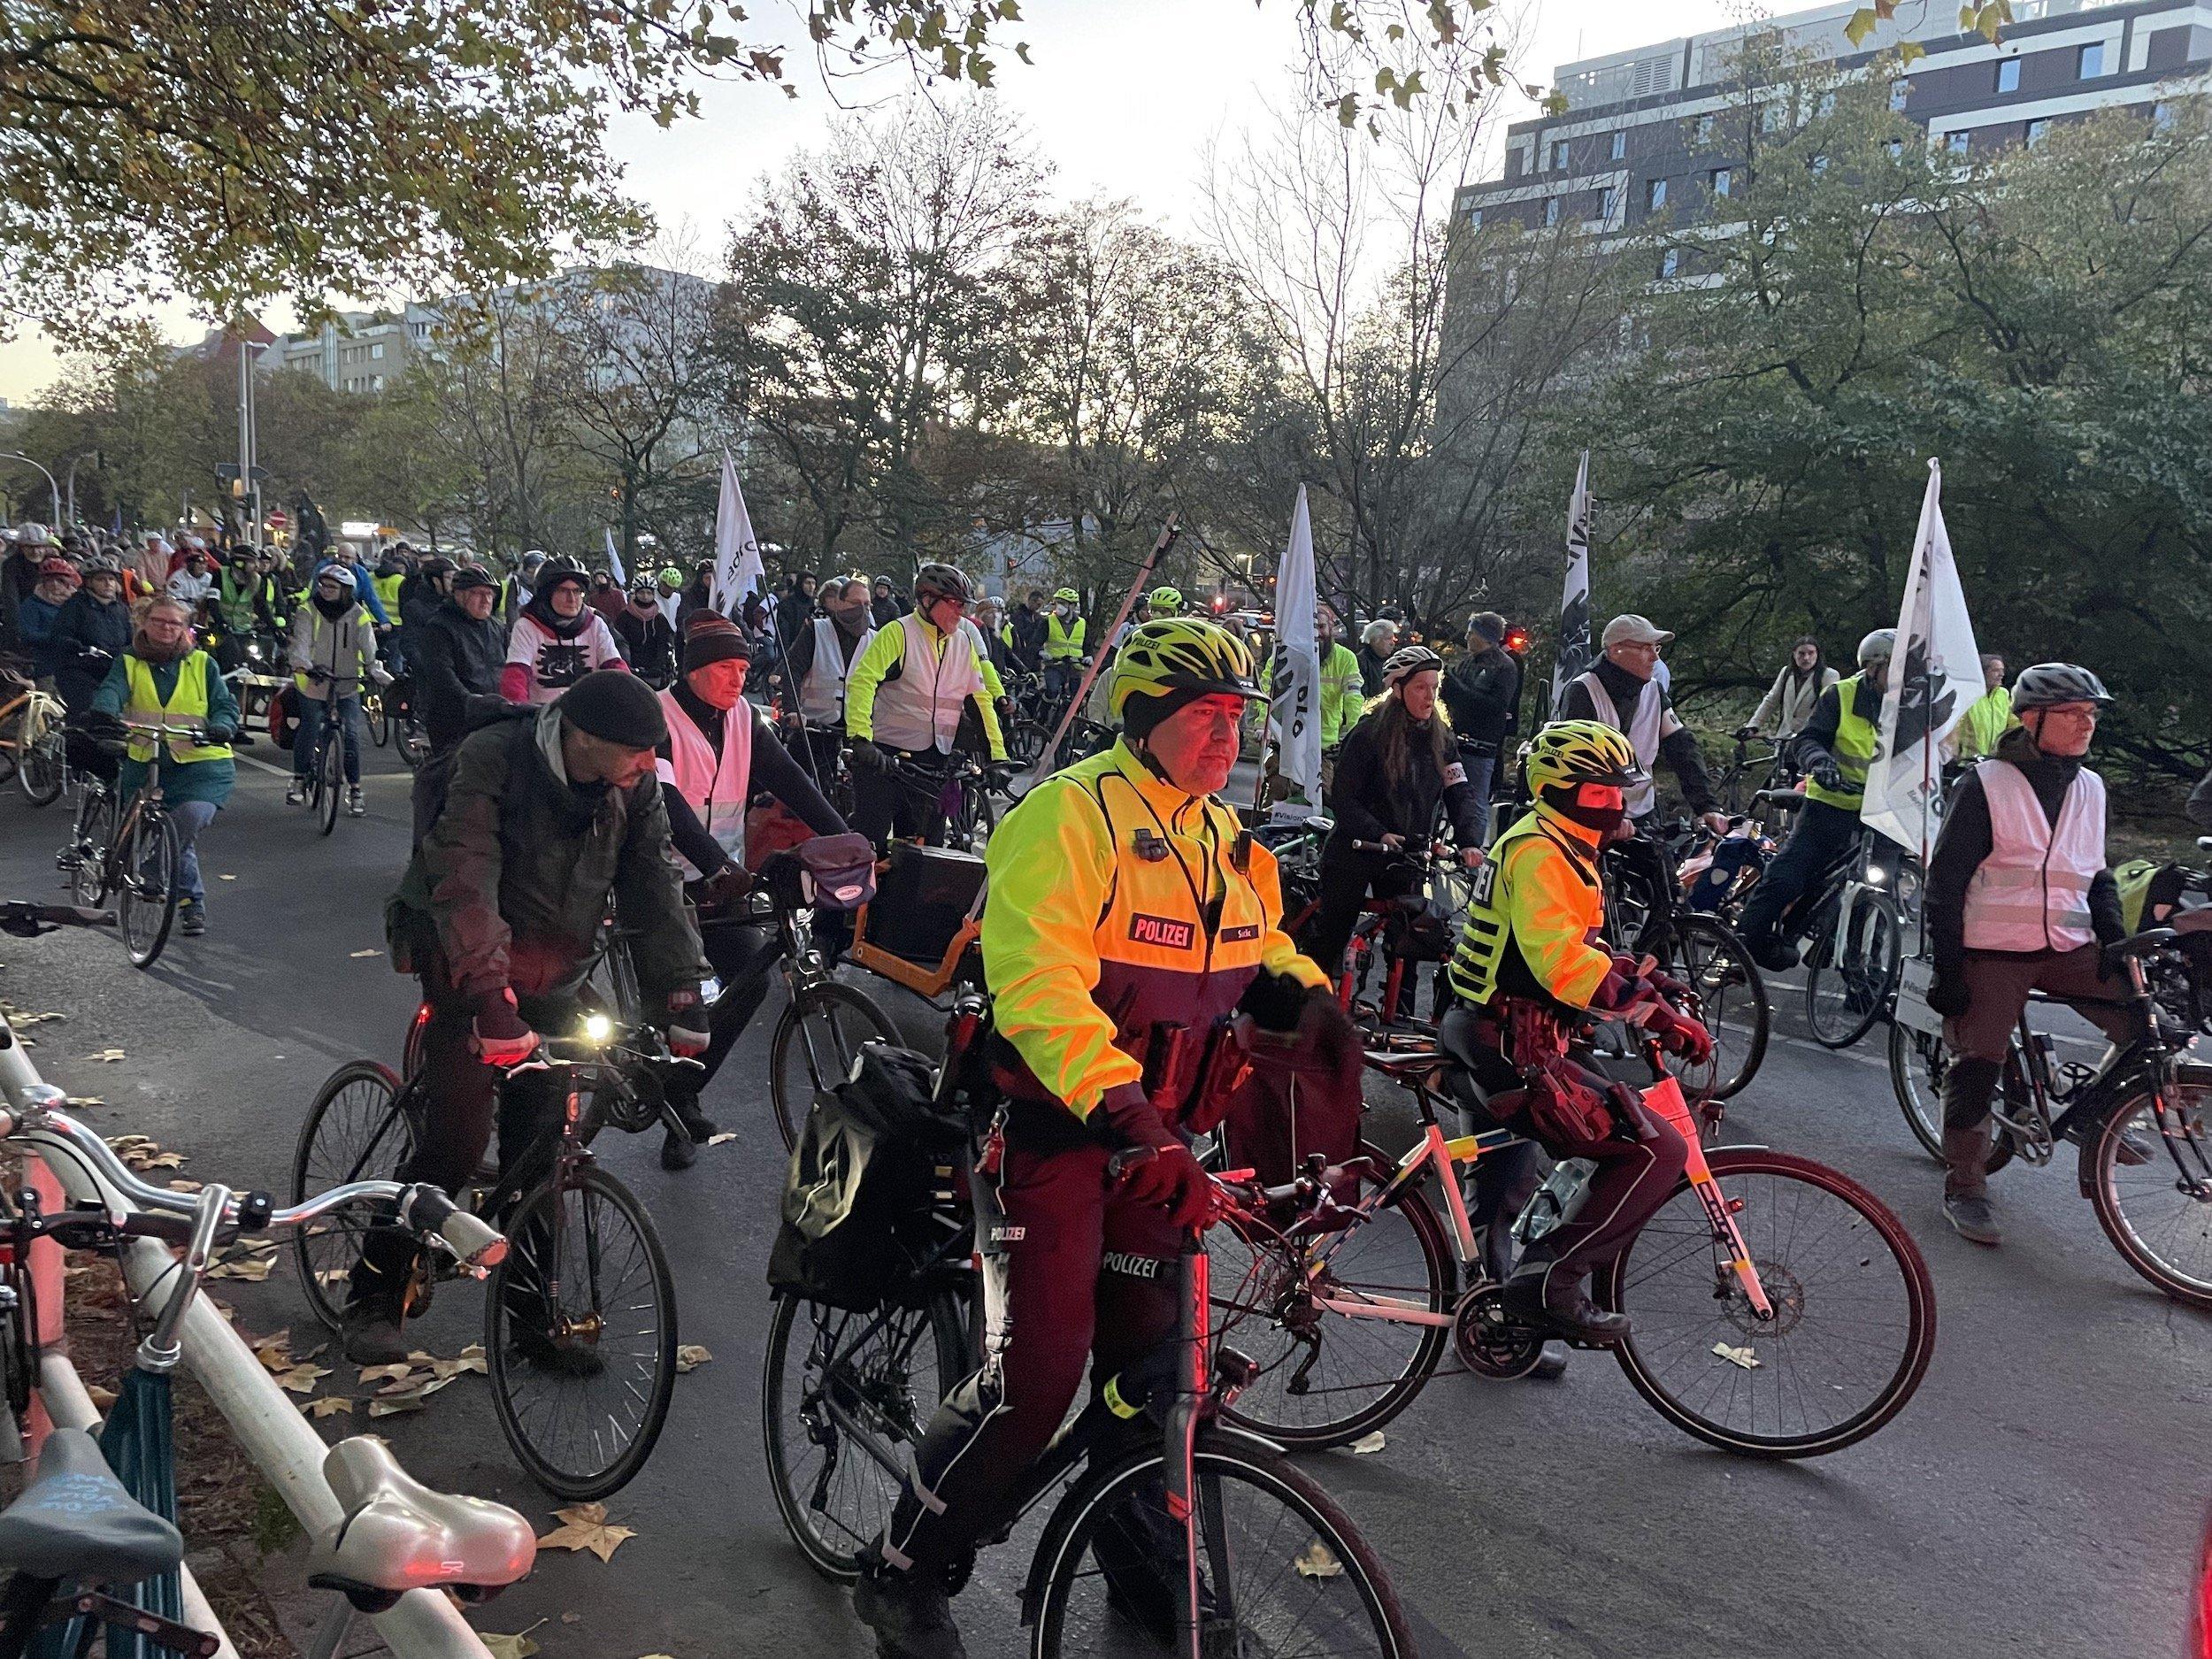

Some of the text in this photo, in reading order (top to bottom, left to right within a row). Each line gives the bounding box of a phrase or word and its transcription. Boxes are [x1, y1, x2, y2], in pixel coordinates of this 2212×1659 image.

[1540, 745, 1564, 758] POLIZEI
[1134, 918, 1188, 947] POLIZEI
[991, 1227, 1025, 1240] POLIZEI
[1103, 1252, 1159, 1279] POLIZEI
